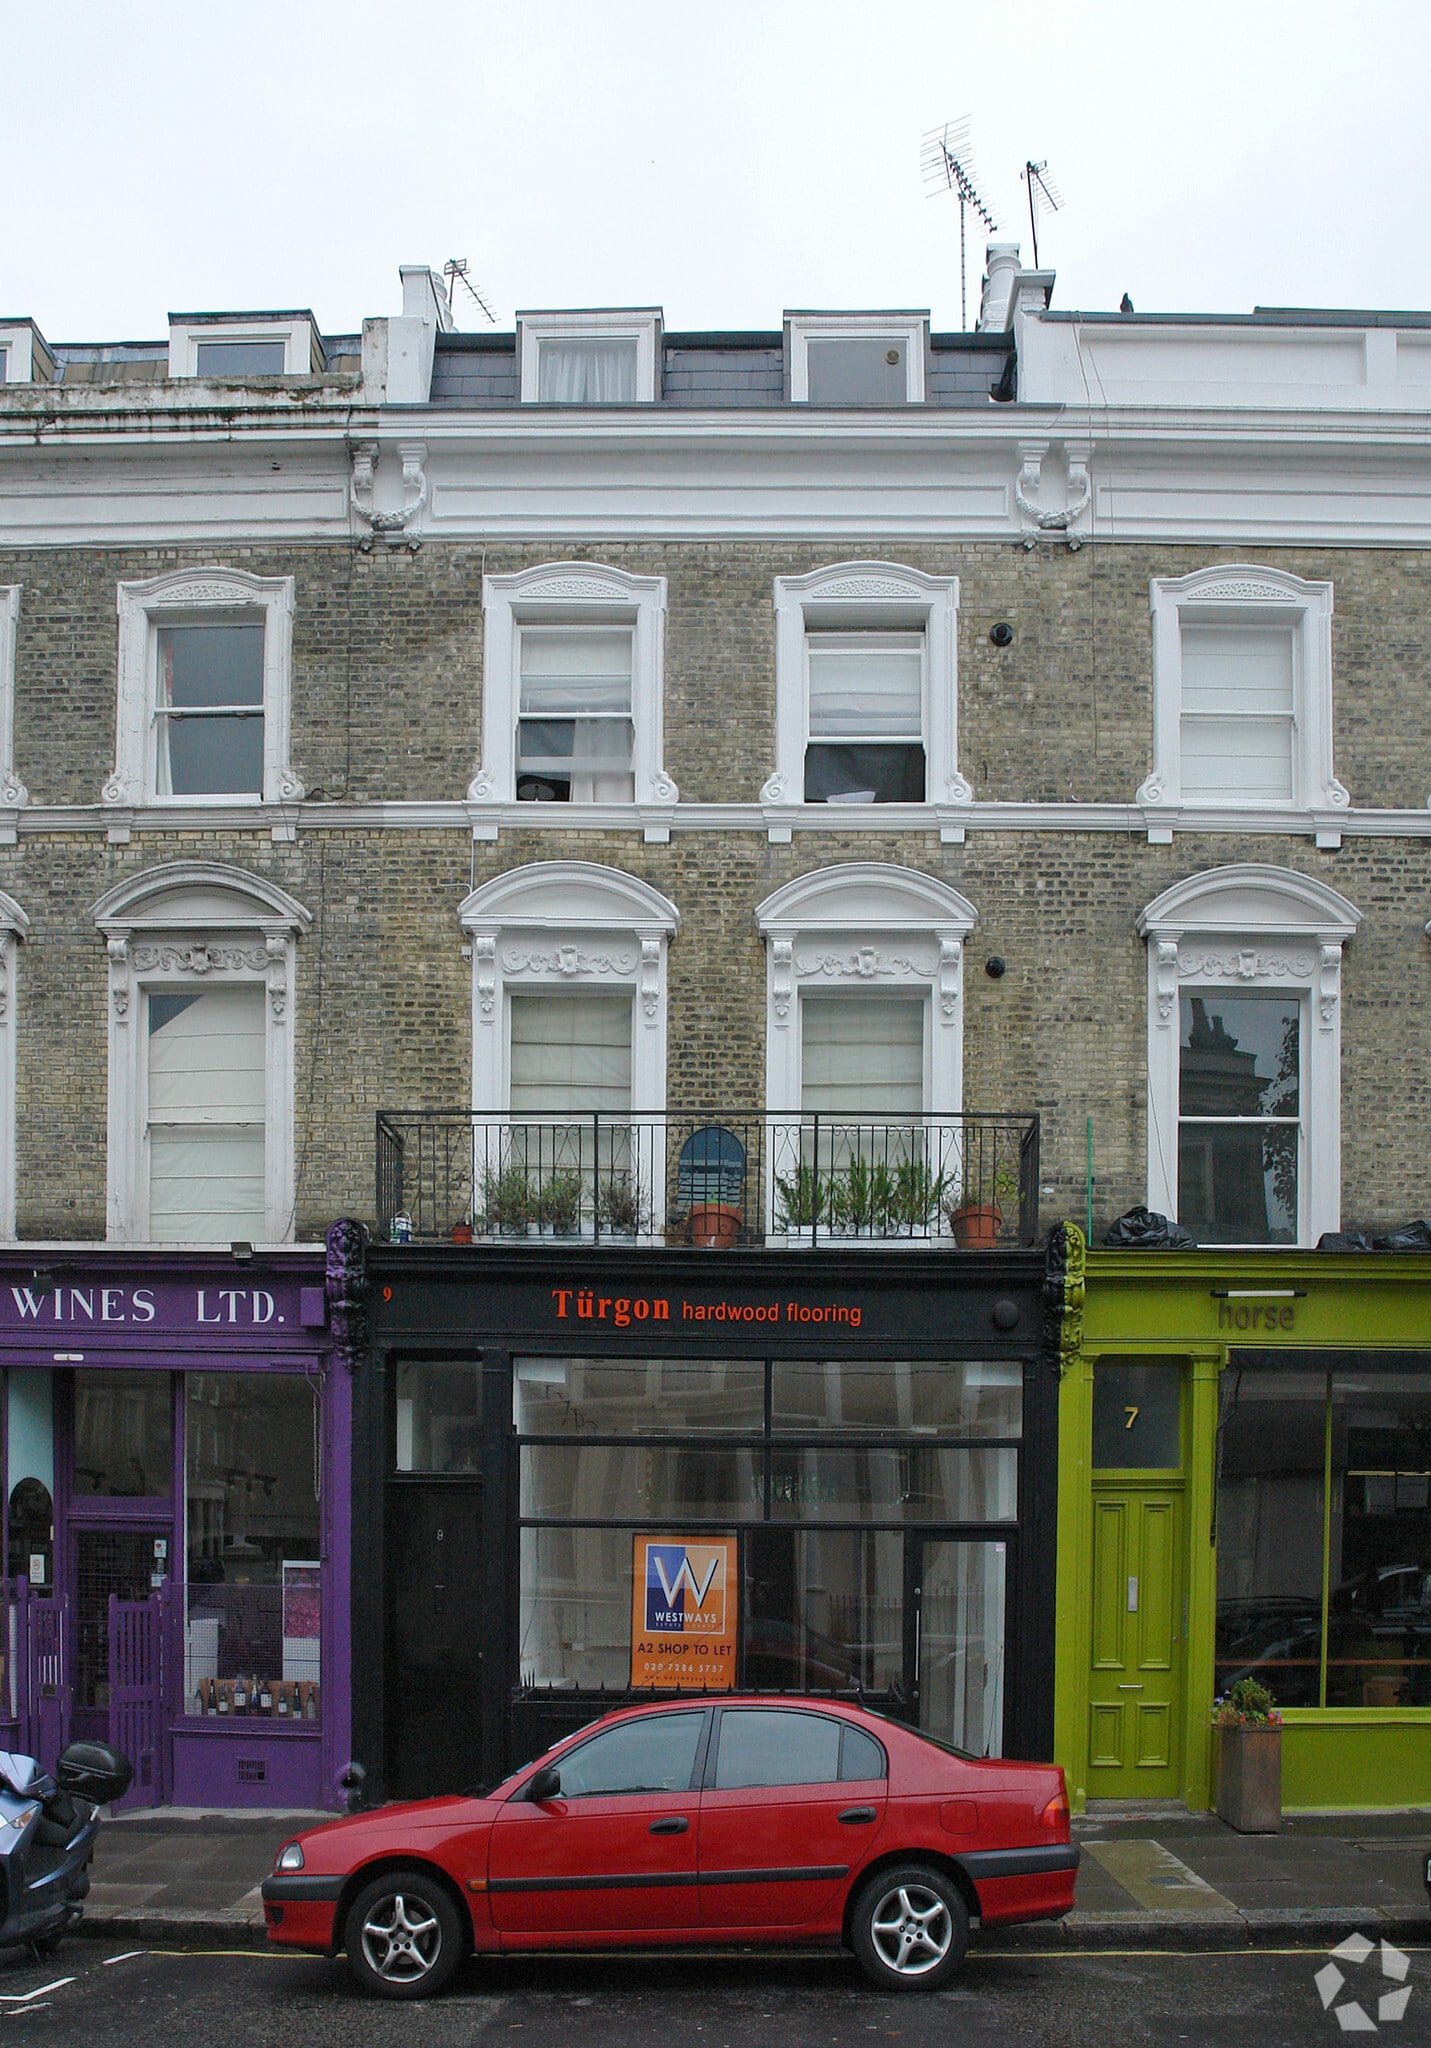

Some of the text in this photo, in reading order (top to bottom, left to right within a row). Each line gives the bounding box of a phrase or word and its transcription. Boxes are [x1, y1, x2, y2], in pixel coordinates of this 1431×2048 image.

[383, 1286, 393, 1302] 9
[11, 1287, 285, 1323] WINES LTD.
[552, 1289, 862, 1328] Türgon hardwood flooring
[1218, 1300, 1296, 1331] horse
[1124, 1406, 1139, 1429] 7
[655, 1612, 717, 1623] WESTWAYS
[637, 1643, 732, 1656] A2 SHOP TO LET
[644, 1662, 664, 1671] 020
